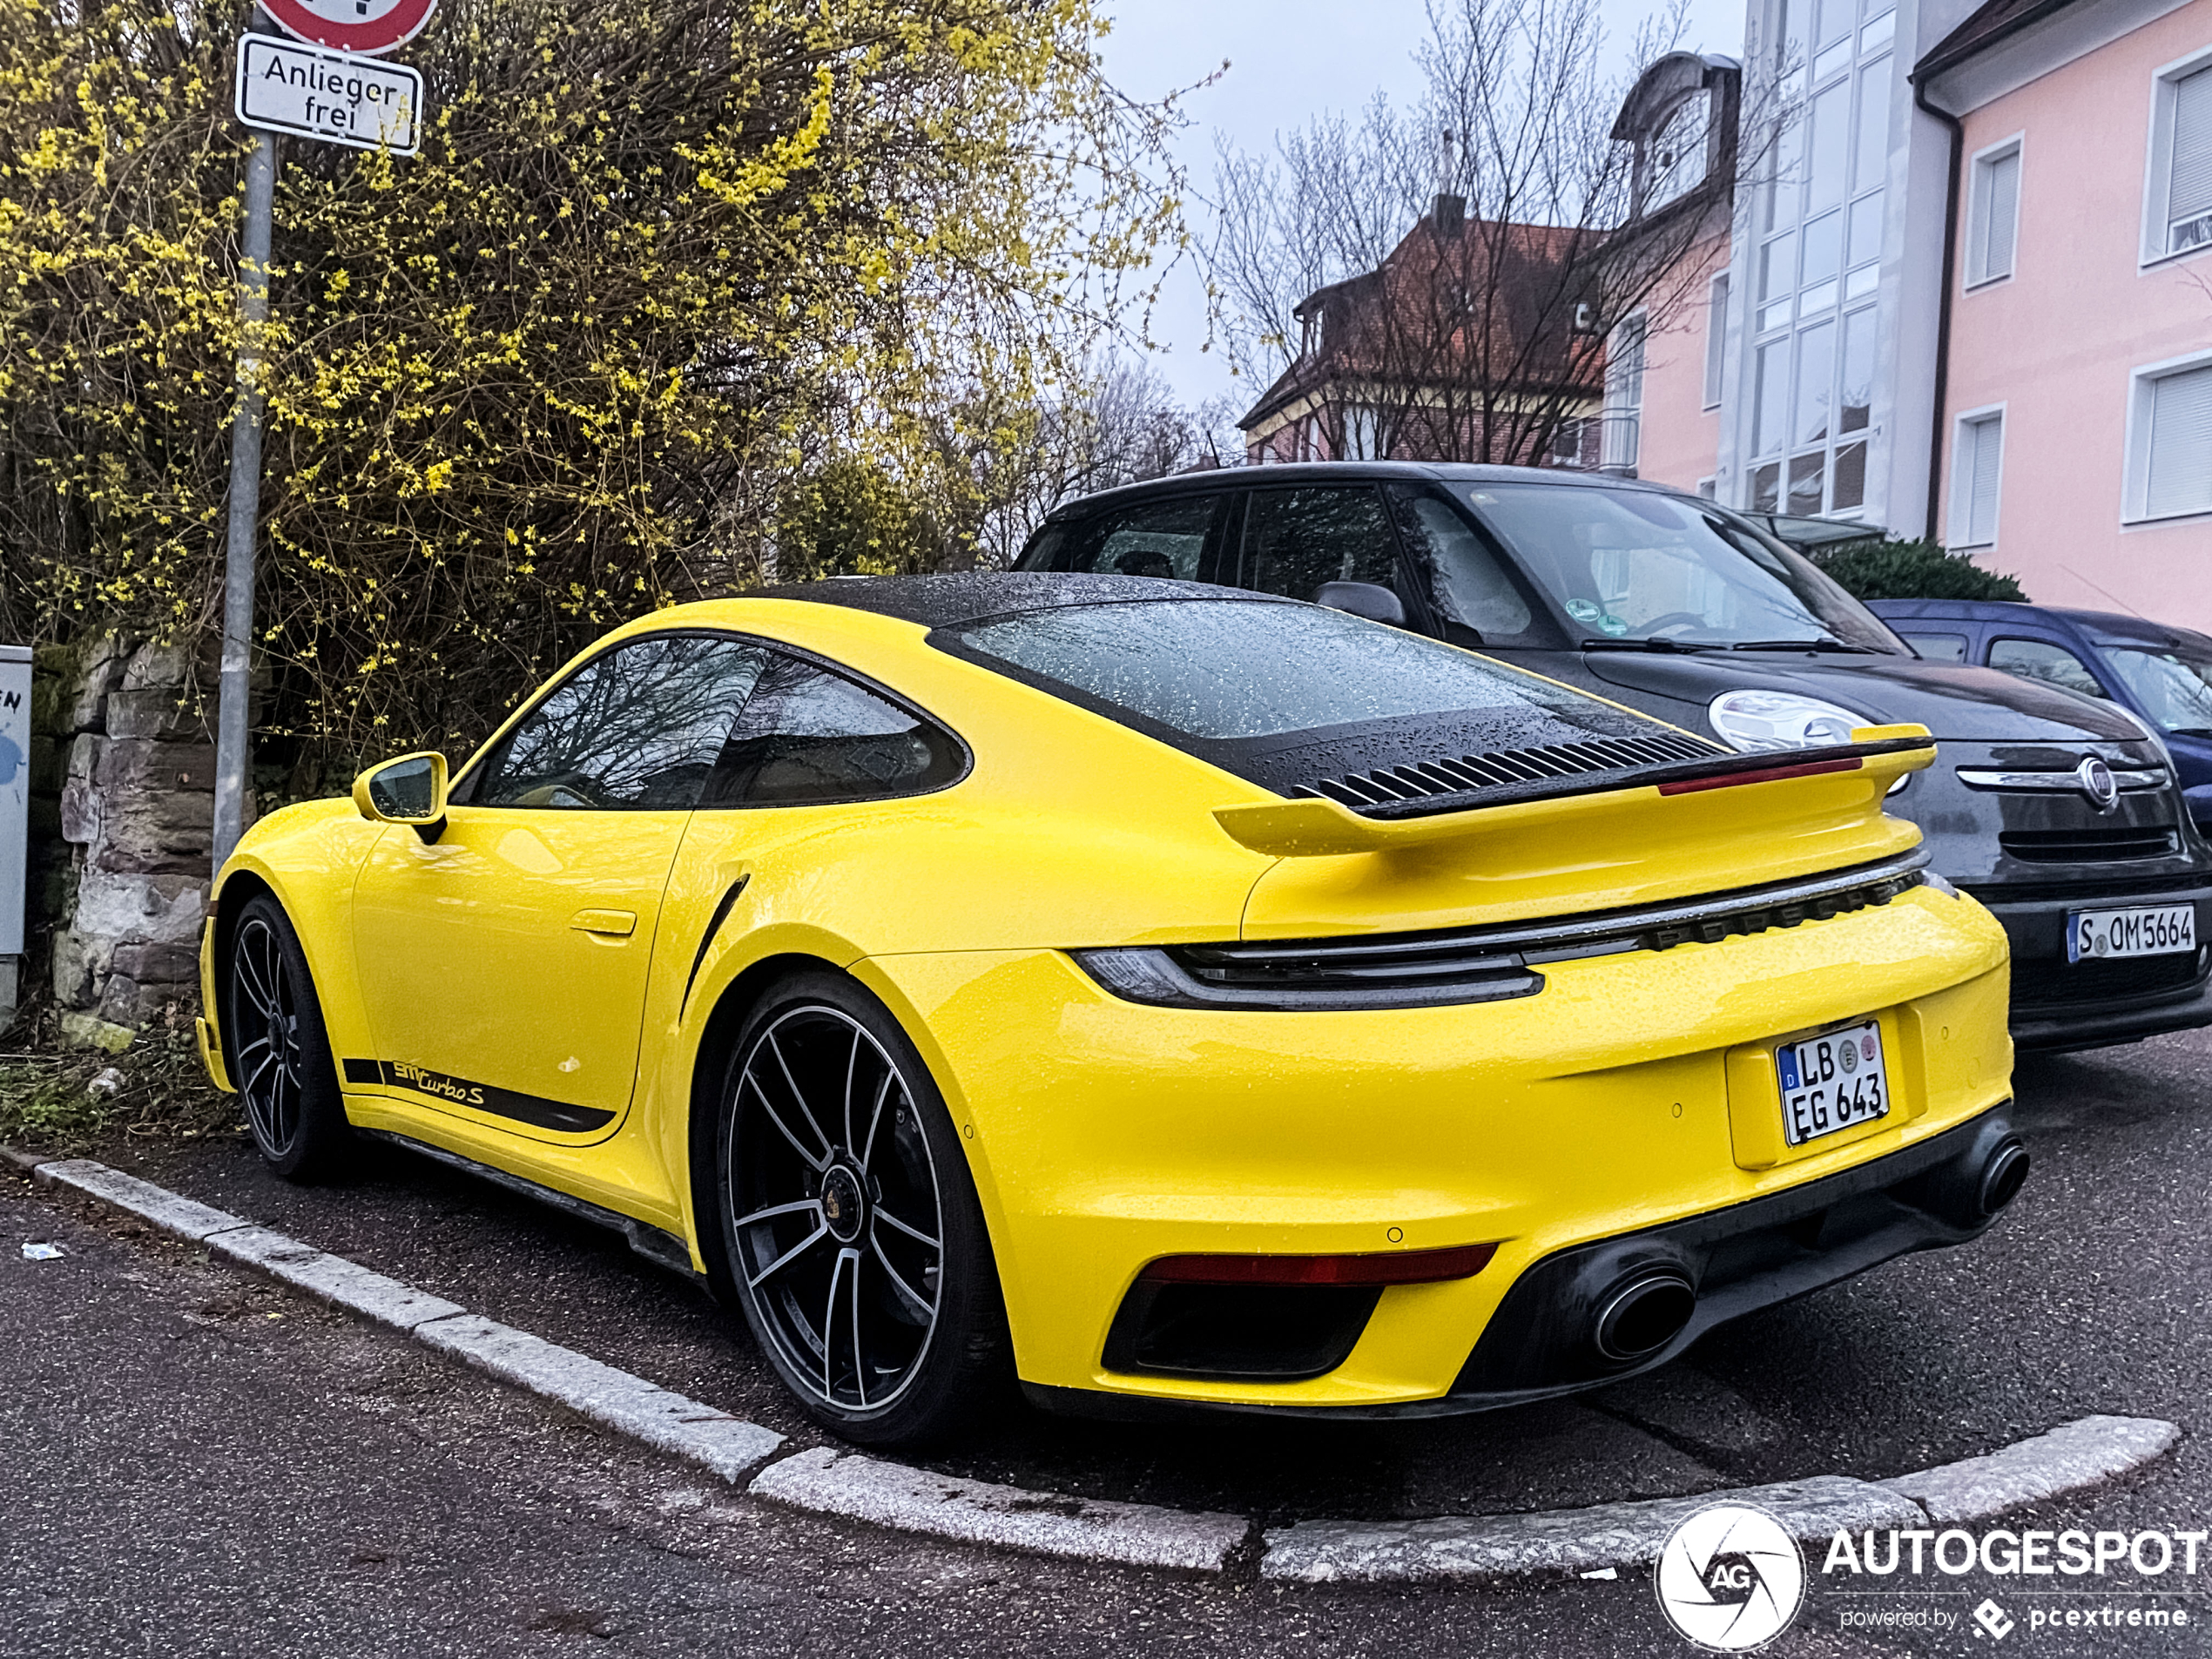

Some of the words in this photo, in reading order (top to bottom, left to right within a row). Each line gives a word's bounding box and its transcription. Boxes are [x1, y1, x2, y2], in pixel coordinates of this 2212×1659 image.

[264, 55, 397, 105] Anlieger
[305, 96, 356, 130] frei
[2080, 919, 2094, 954] S
[1787, 1074, 1795, 1088] D
[1800, 1042, 1834, 1087] LB
[467, 1088, 484, 1104] S
[1792, 1090, 1828, 1136] EG
[1837, 1073, 1881, 1122] 643
